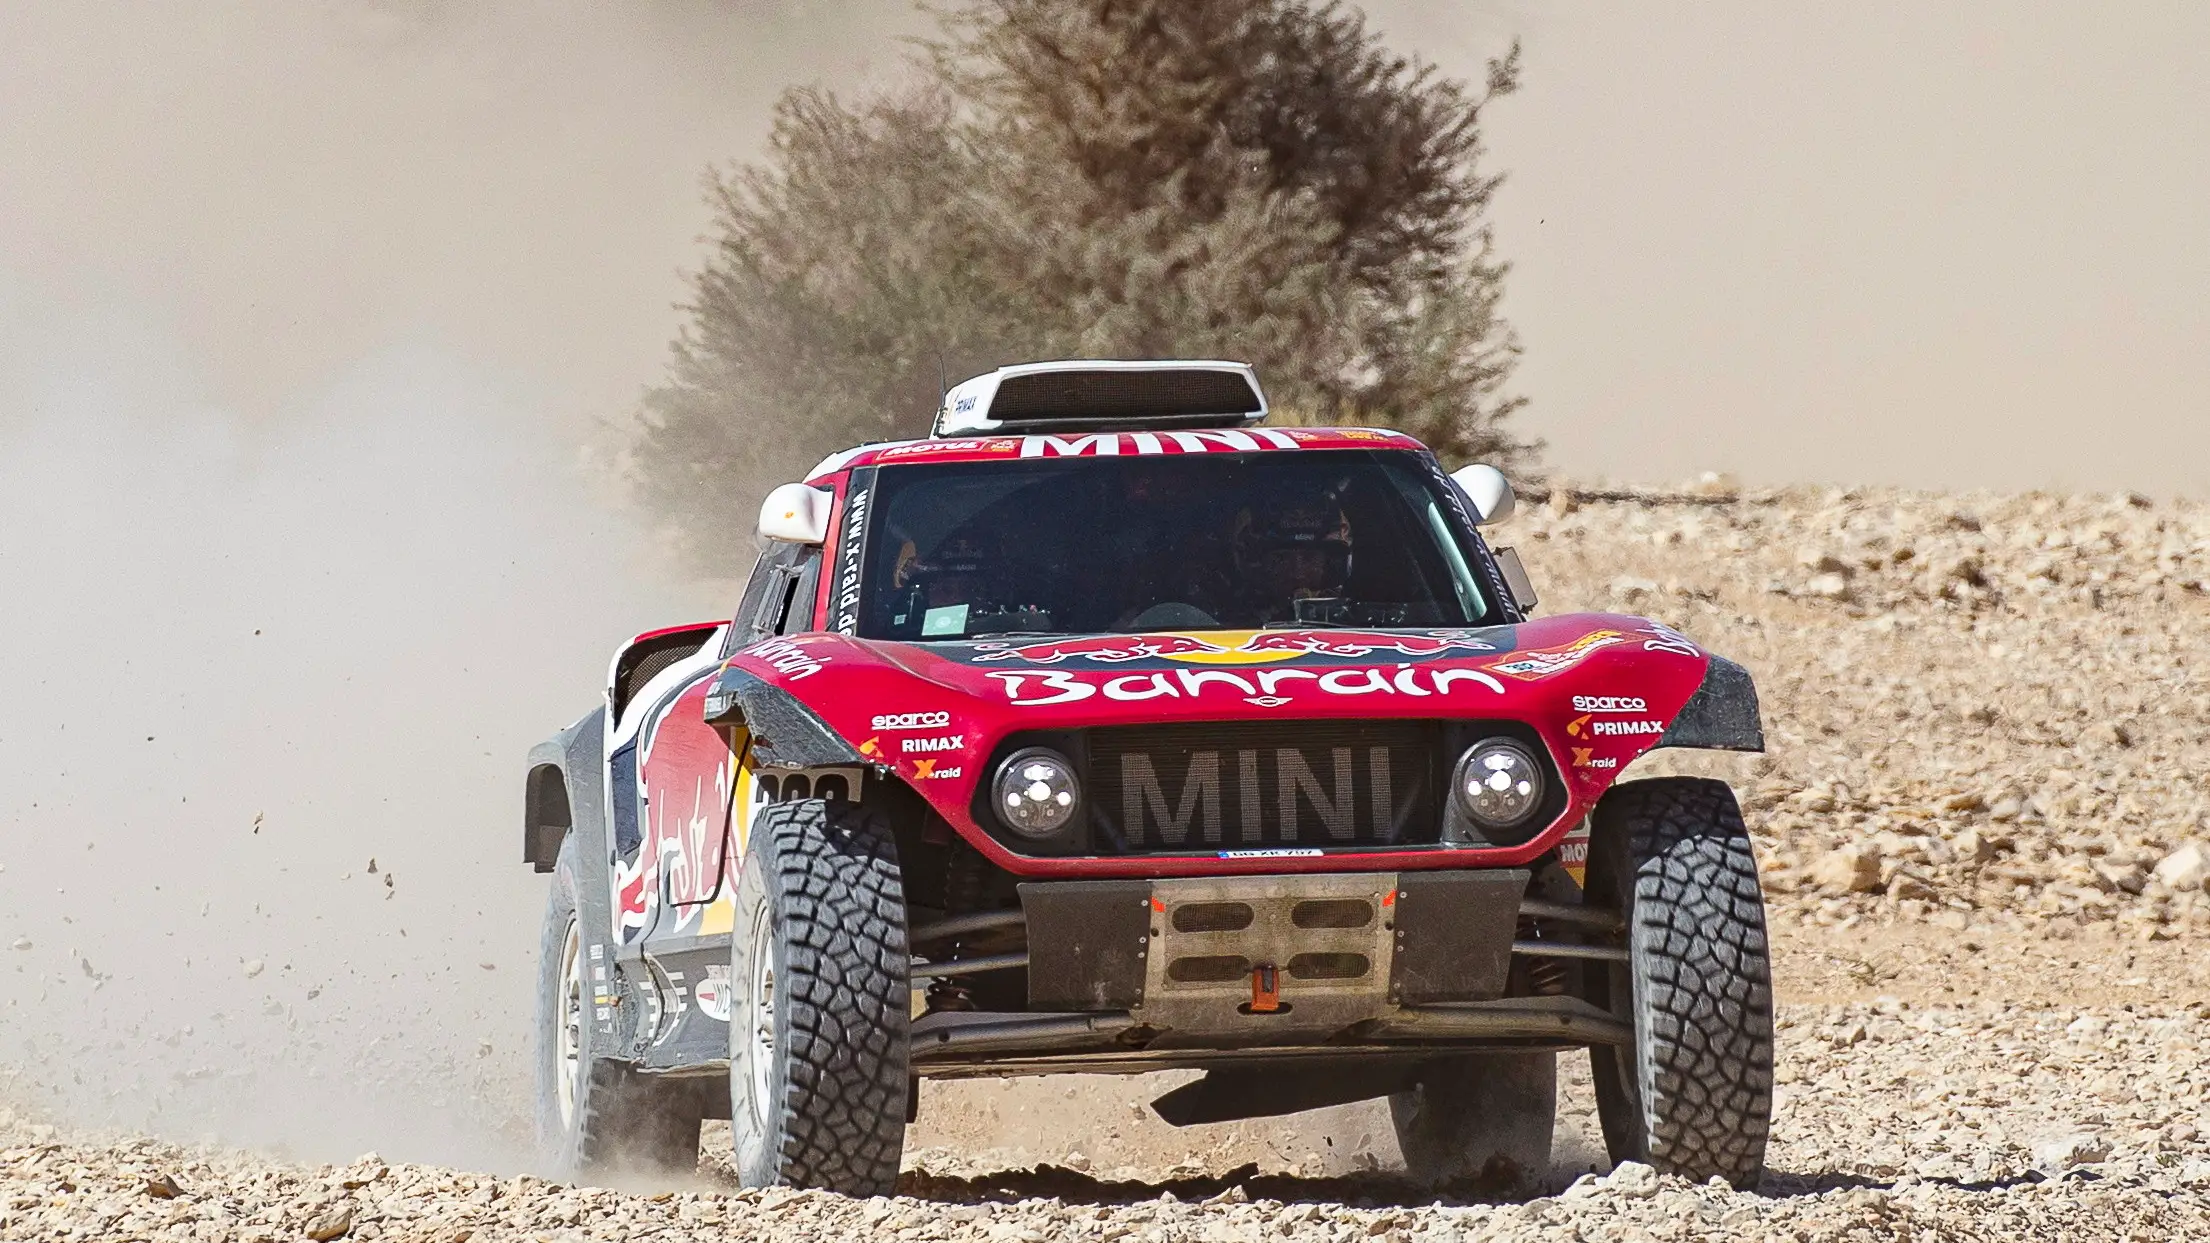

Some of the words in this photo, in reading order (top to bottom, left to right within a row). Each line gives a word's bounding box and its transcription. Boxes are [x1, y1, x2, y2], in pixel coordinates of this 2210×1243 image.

[886, 441, 978, 456] MOTUL
[1020, 429, 1300, 458] MINI
[985, 663, 1506, 706] Bahrain
[1572, 695, 1648, 713] sparco
[871, 711, 950, 730] sparco
[1592, 720, 1665, 735] PRIMAX
[902, 735, 964, 752] RIMAX
[1121, 746, 1392, 844] MINI
